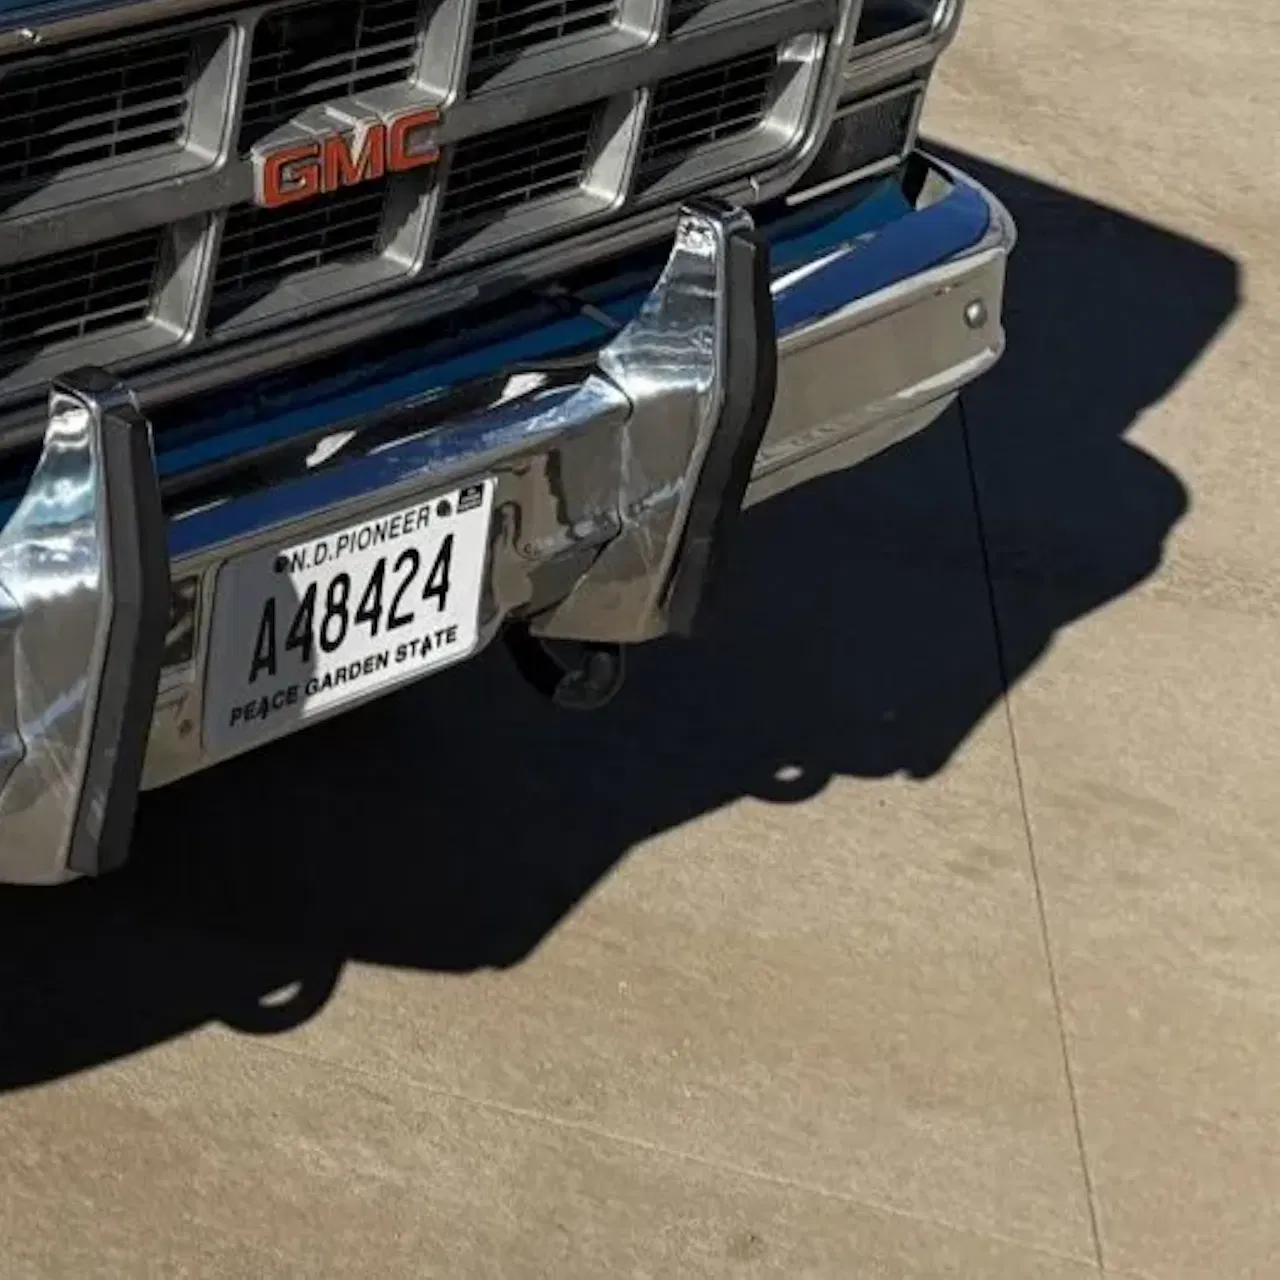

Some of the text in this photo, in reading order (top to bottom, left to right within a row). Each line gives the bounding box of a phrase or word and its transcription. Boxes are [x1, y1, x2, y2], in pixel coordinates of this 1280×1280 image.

[261, 106, 441, 208] GMC
[335, 505, 431, 560] PIONEER
[248, 533, 455, 685] A48424
[229, 624, 459, 728] PEACE GARDEN STATE
